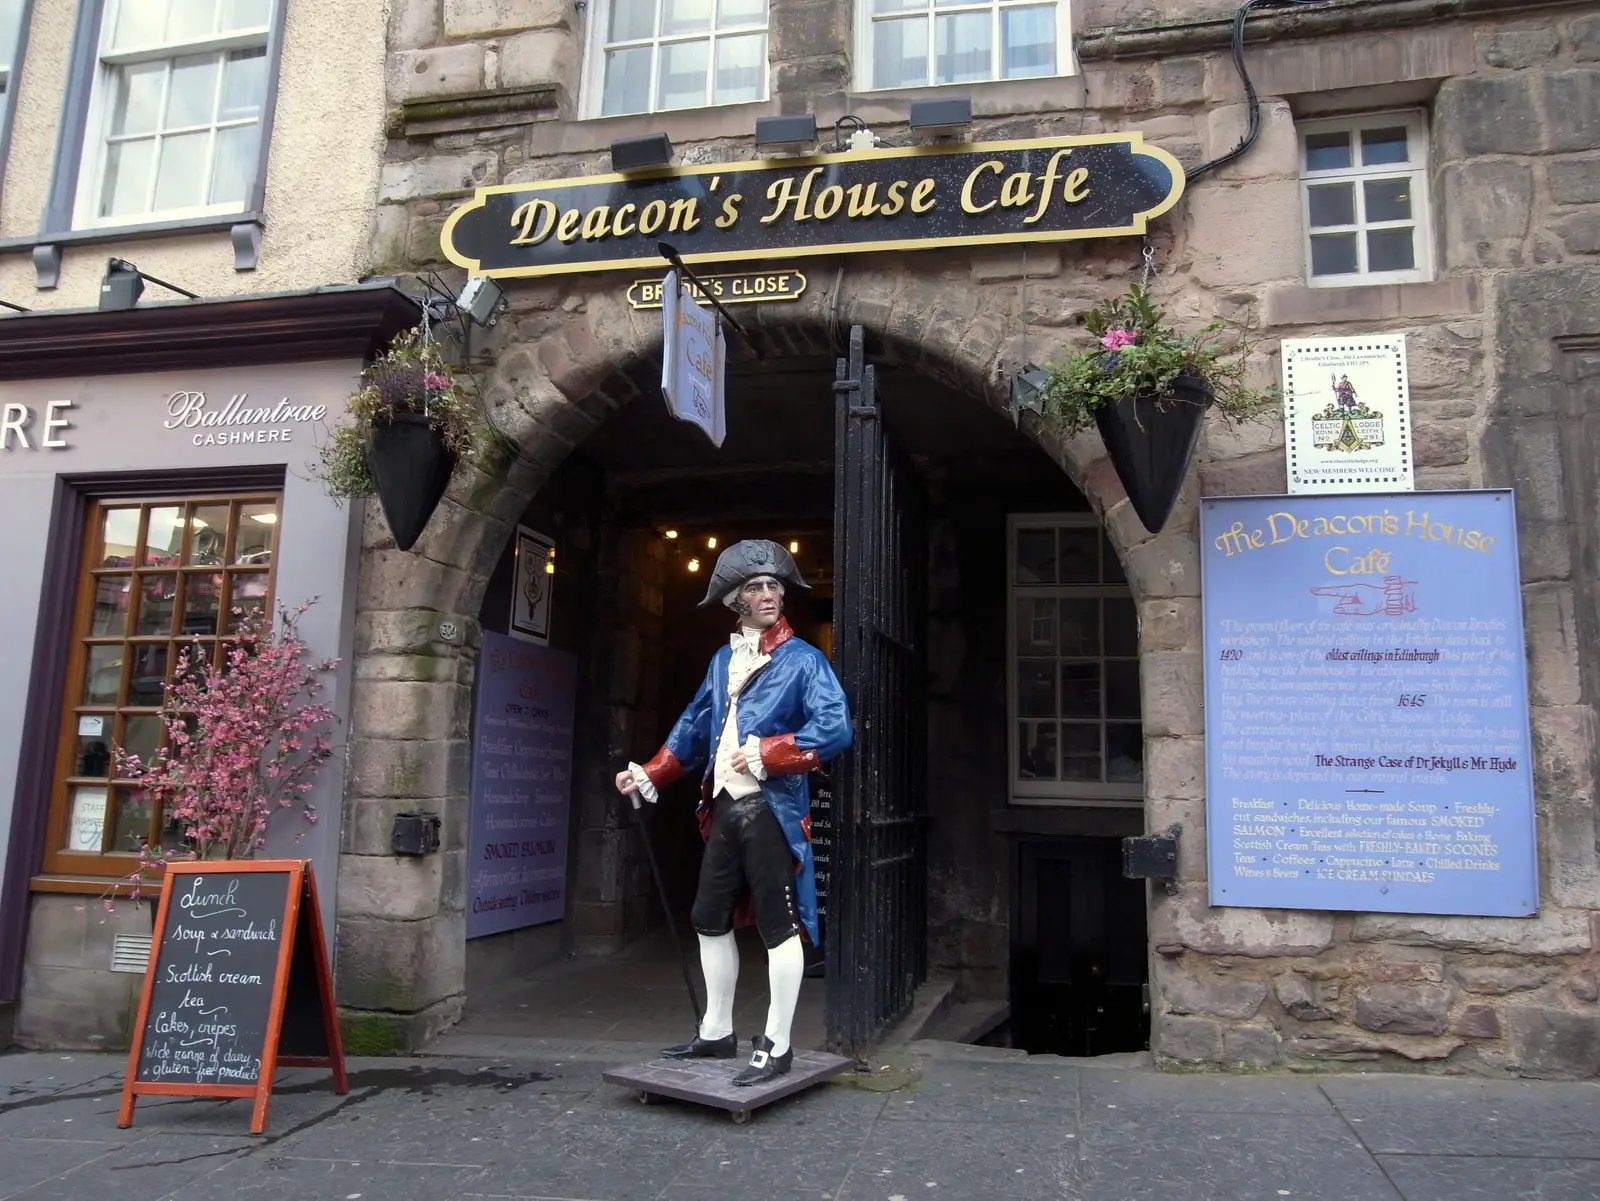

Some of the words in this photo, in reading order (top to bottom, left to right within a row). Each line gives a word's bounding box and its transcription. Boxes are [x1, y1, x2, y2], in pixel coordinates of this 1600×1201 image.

[509, 176, 742, 246] Deacon's
[760, 166, 936, 223] House
[960, 148, 1090, 223] Cafe
[732, 276, 789, 295] CLOSE
[164, 390, 328, 429] Ballantrae
[193, 429, 293, 447] CASHMERE
[1215, 521, 1263, 556] The
[1266, 509, 1399, 544] Deacon's
[1404, 510, 1496, 555] House
[1326, 648, 1350, 661] oldest
[1350, 648, 1383, 664] ceilings
[1384, 649, 1395, 661] in
[1394, 648, 1440, 664] Edinburgh
[1397, 694, 1428, 707] 1645
[1314, 754, 1333, 767] The
[1334, 755, 1375, 770] Strange
[1378, 756, 1403, 768] Case
[1404, 756, 1415, 768] of
[1416, 757, 1428, 769] Dr
[1428, 756, 1461, 771] Jekyll
[1471, 756, 1488, 769] Mr
[1489, 757, 1517, 772] Hyde
[1232, 797, 1275, 809] Breakfast
[1298, 799, 1342, 811] Delicious
[1408, 800, 1437, 815] Soup
[1233, 813, 1251, 822] cut
[1313, 813, 1362, 826] including
[1364, 817, 1383, 825] our
[1386, 814, 1427, 826] famous
[1431, 816, 1484, 828] SMOKED
[1232, 825, 1286, 836] SALMON
[1300, 826, 1343, 838] Excellent
[1456, 830, 1491, 844] Baking
[520, 840, 556, 857] SALMON
[1232, 838, 1272, 850] Scottish
[1276, 840, 1308, 851] Cream
[1311, 840, 1332, 852] Teas
[1334, 841, 1356, 852] with
[1444, 843, 1499, 856] SCONES
[1233, 852, 1256, 864] Teas
[1272, 854, 1316, 865] Coffees
[1325, 855, 1384, 869] Cappucino
[1426, 858, 1462, 869] Chilled
[1464, 859, 1500, 871] Drinks
[1234, 866, 1264, 878] Wines
[1273, 868, 1300, 878] Beers
[1316, 868, 1335, 879] ICE
[1338, 870, 1379, 881] CREAM
[1382, 870, 1436, 882] SUNDAES
[180, 877, 239, 909] Lunch
[172, 924, 205, 953] soup
[221, 919, 276, 942] sandwich
[166, 964, 213, 984] Scottish
[219, 973, 262, 985] cream
[178, 989, 204, 1009] tea
[174, 1049, 205, 1070] range
[209, 1047, 221, 1071] of
[152, 1060, 191, 1082] gluten
[195, 1062, 215, 1083] free
